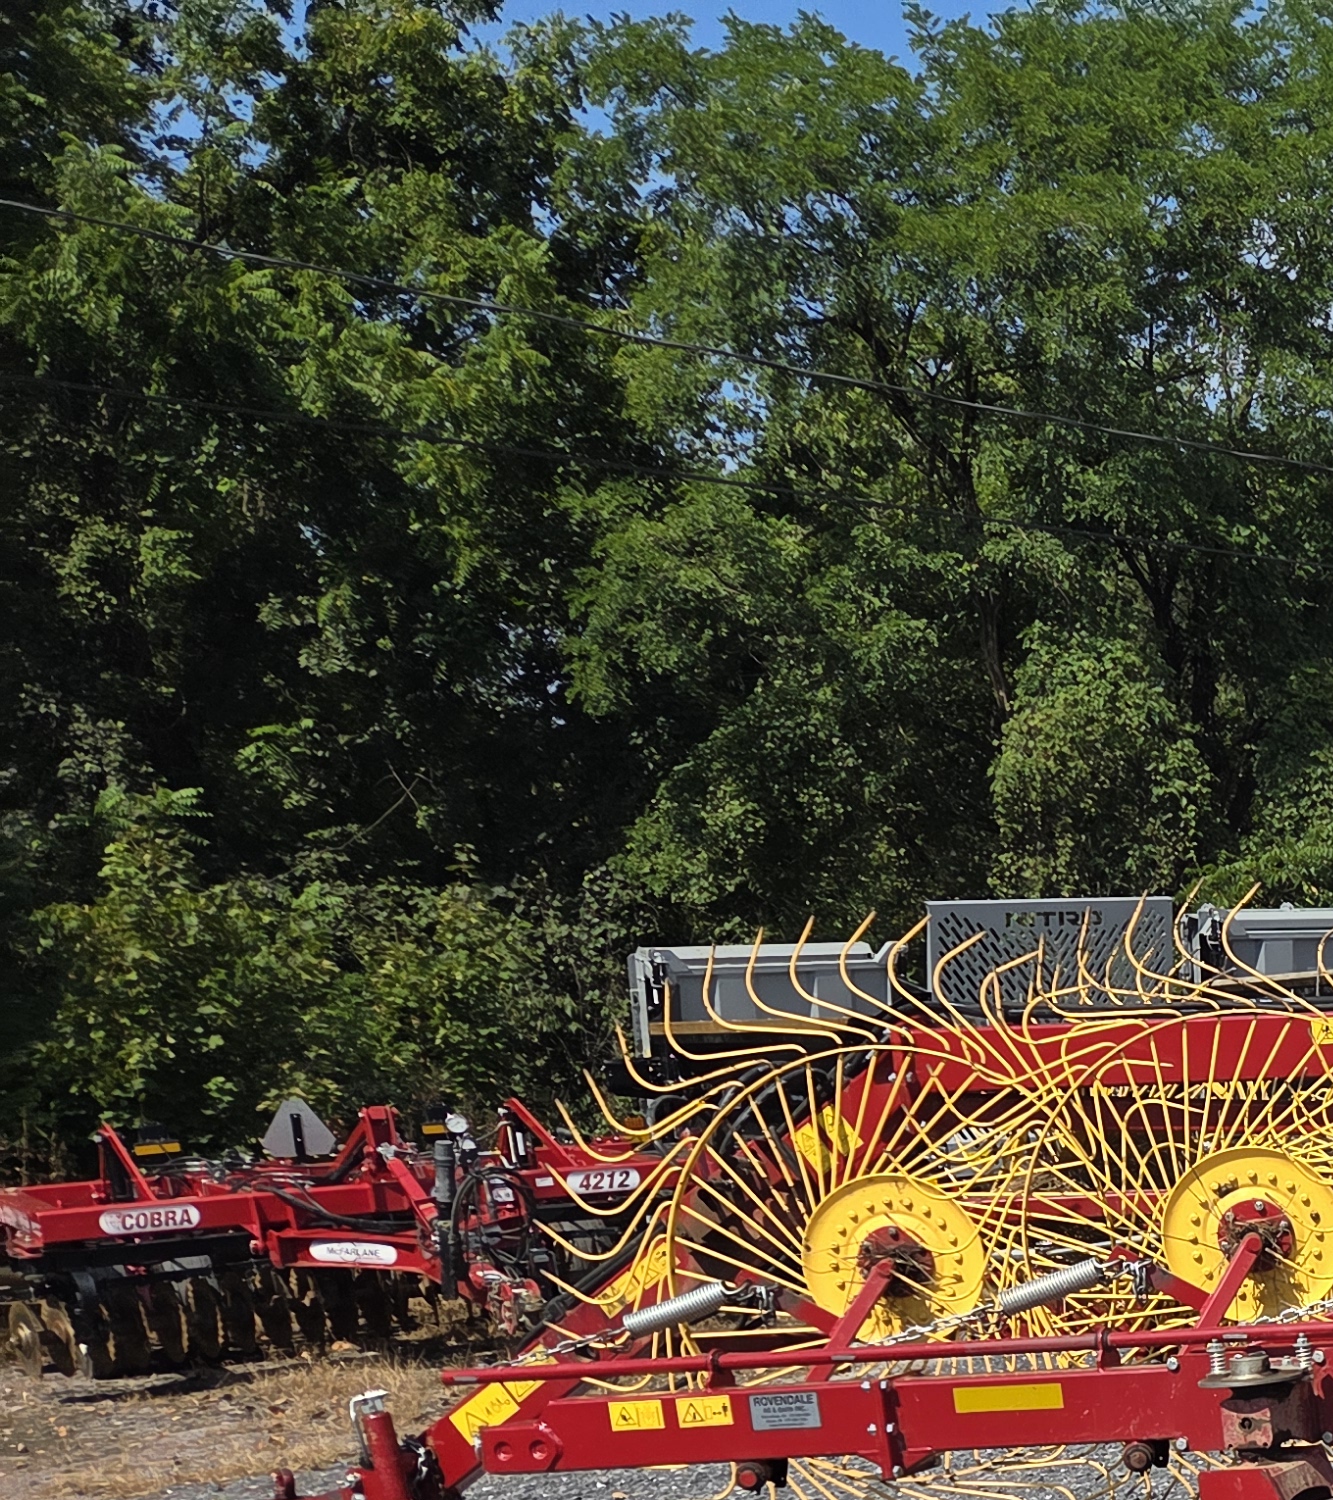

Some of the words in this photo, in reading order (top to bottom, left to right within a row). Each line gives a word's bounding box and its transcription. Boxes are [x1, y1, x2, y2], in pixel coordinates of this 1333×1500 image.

[579, 1170, 631, 1190] 4212
[121, 1209, 194, 1230] COBRA
[753, 1393, 815, 1407] ROVENDALE
